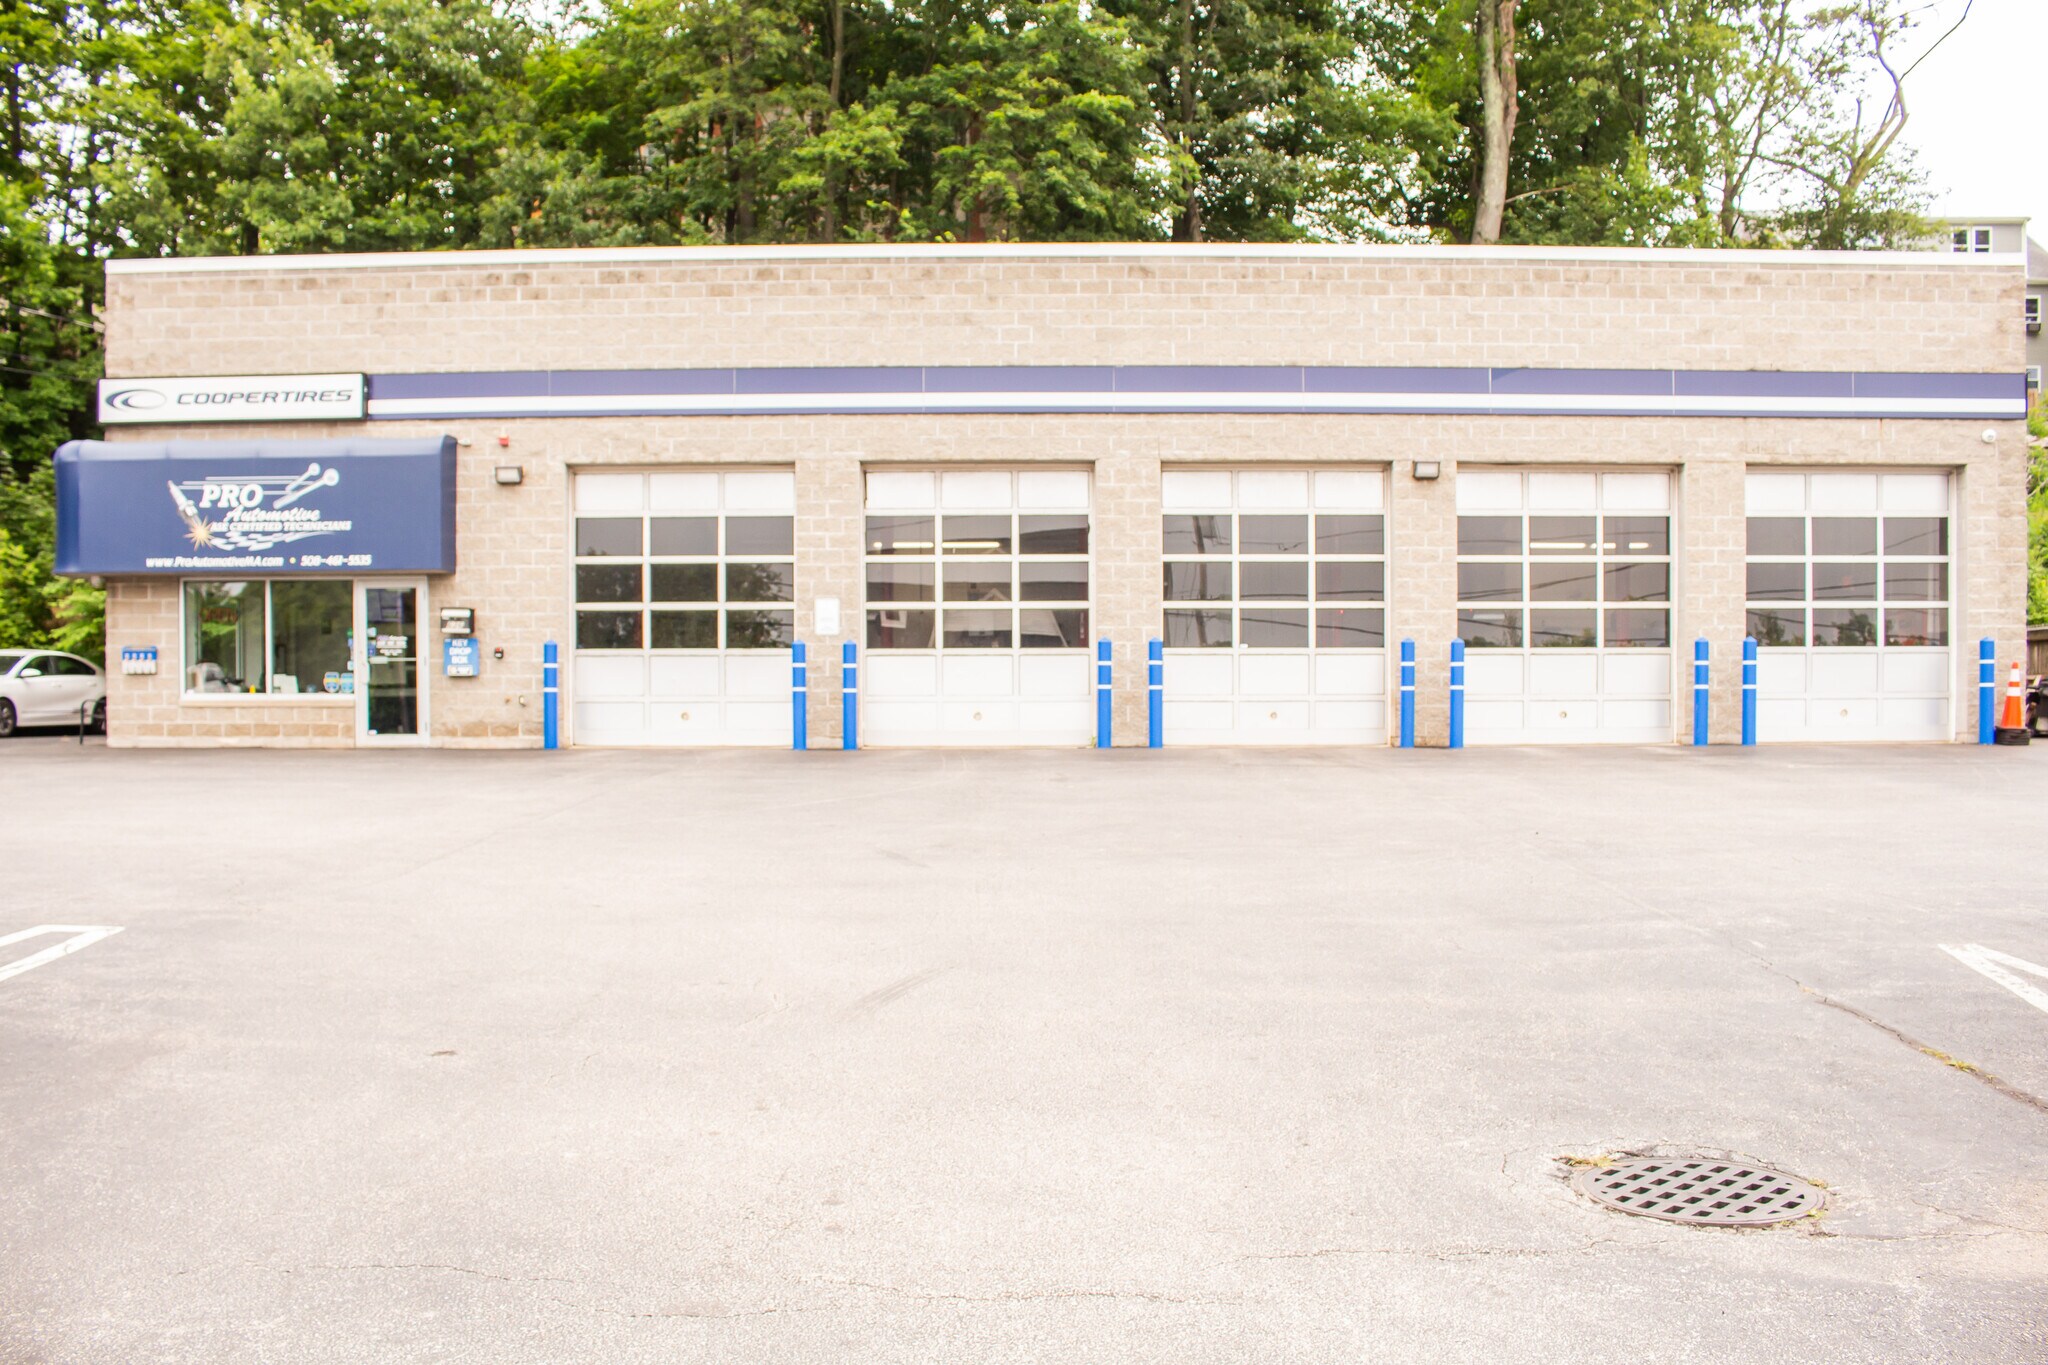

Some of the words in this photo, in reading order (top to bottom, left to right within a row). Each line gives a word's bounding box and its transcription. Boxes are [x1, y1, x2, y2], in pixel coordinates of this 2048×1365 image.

[199, 484, 263, 508] PRO
[223, 505, 321, 522] Automotive
[229, 522, 283, 531] CERTIFIED
[283, 521, 351, 531] TECHNICIANS
[452, 639, 468, 647] KEY
[449, 647, 472, 656] DROP
[451, 656, 468, 664] BOX
